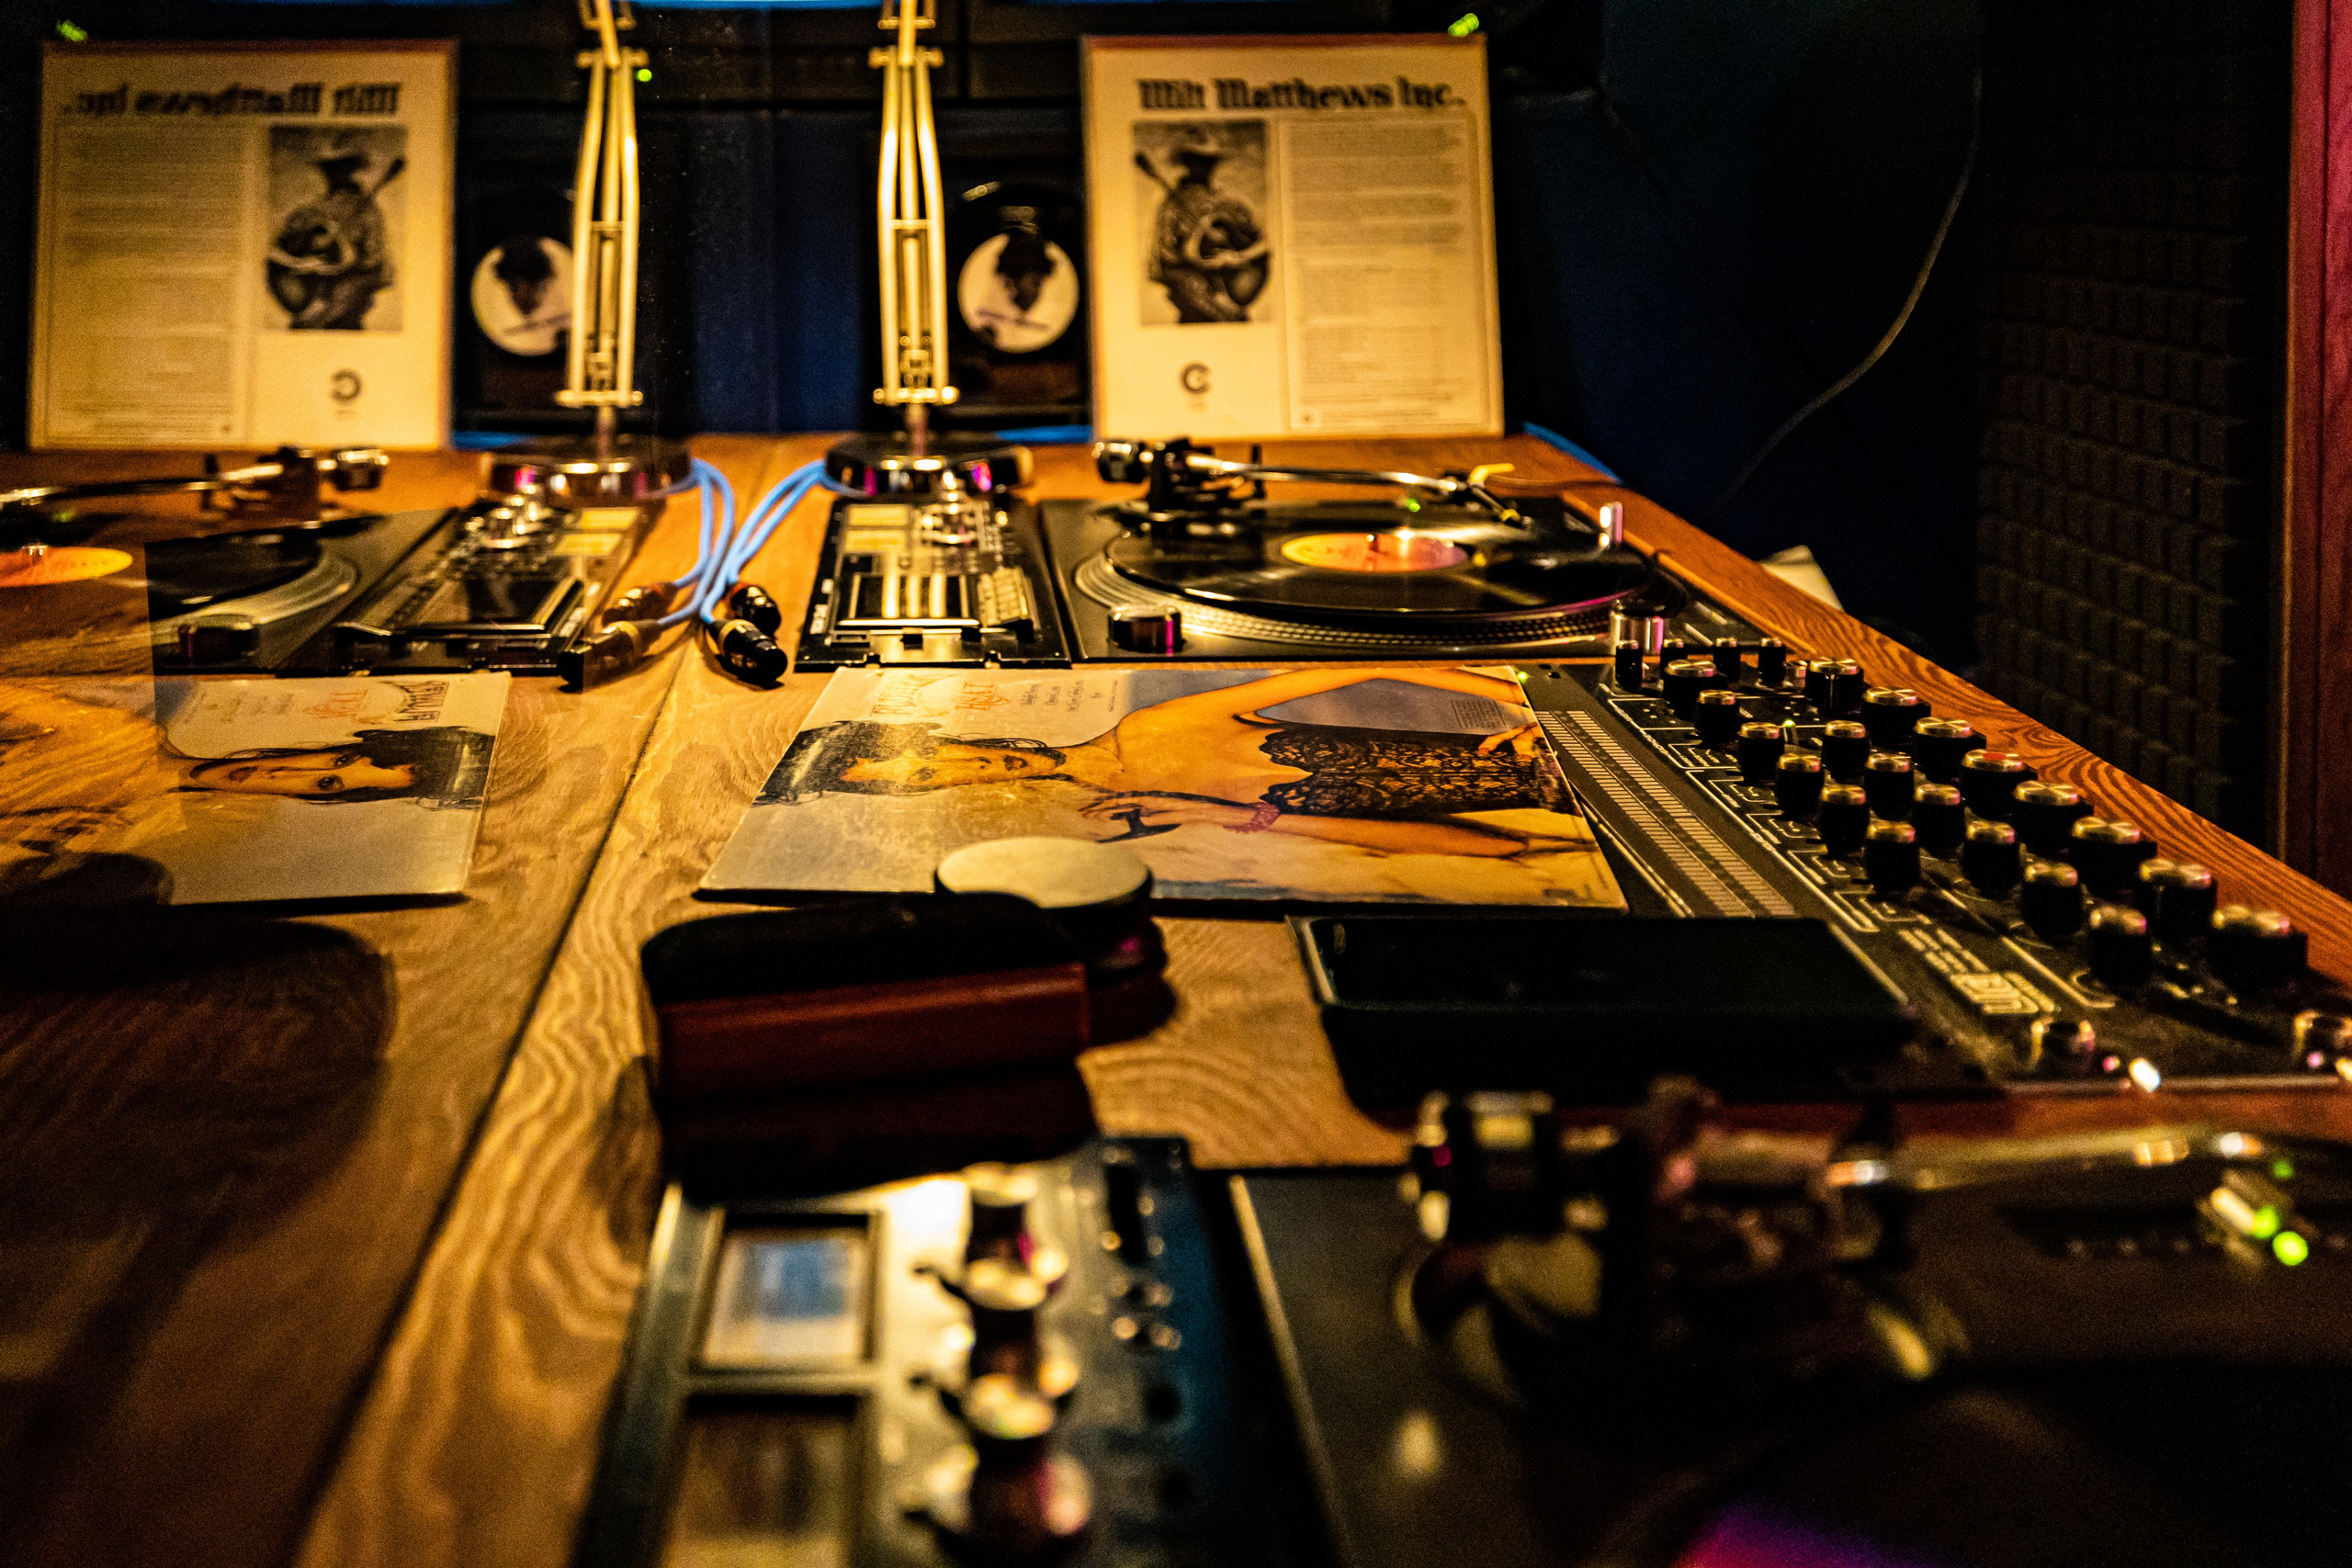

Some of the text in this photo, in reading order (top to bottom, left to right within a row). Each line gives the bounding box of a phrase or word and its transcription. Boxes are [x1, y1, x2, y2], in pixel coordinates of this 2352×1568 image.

[1213, 76, 1394, 108] Matthews
[1396, 73, 1466, 108] Inc.
[952, 682, 1010, 711] HEAT
